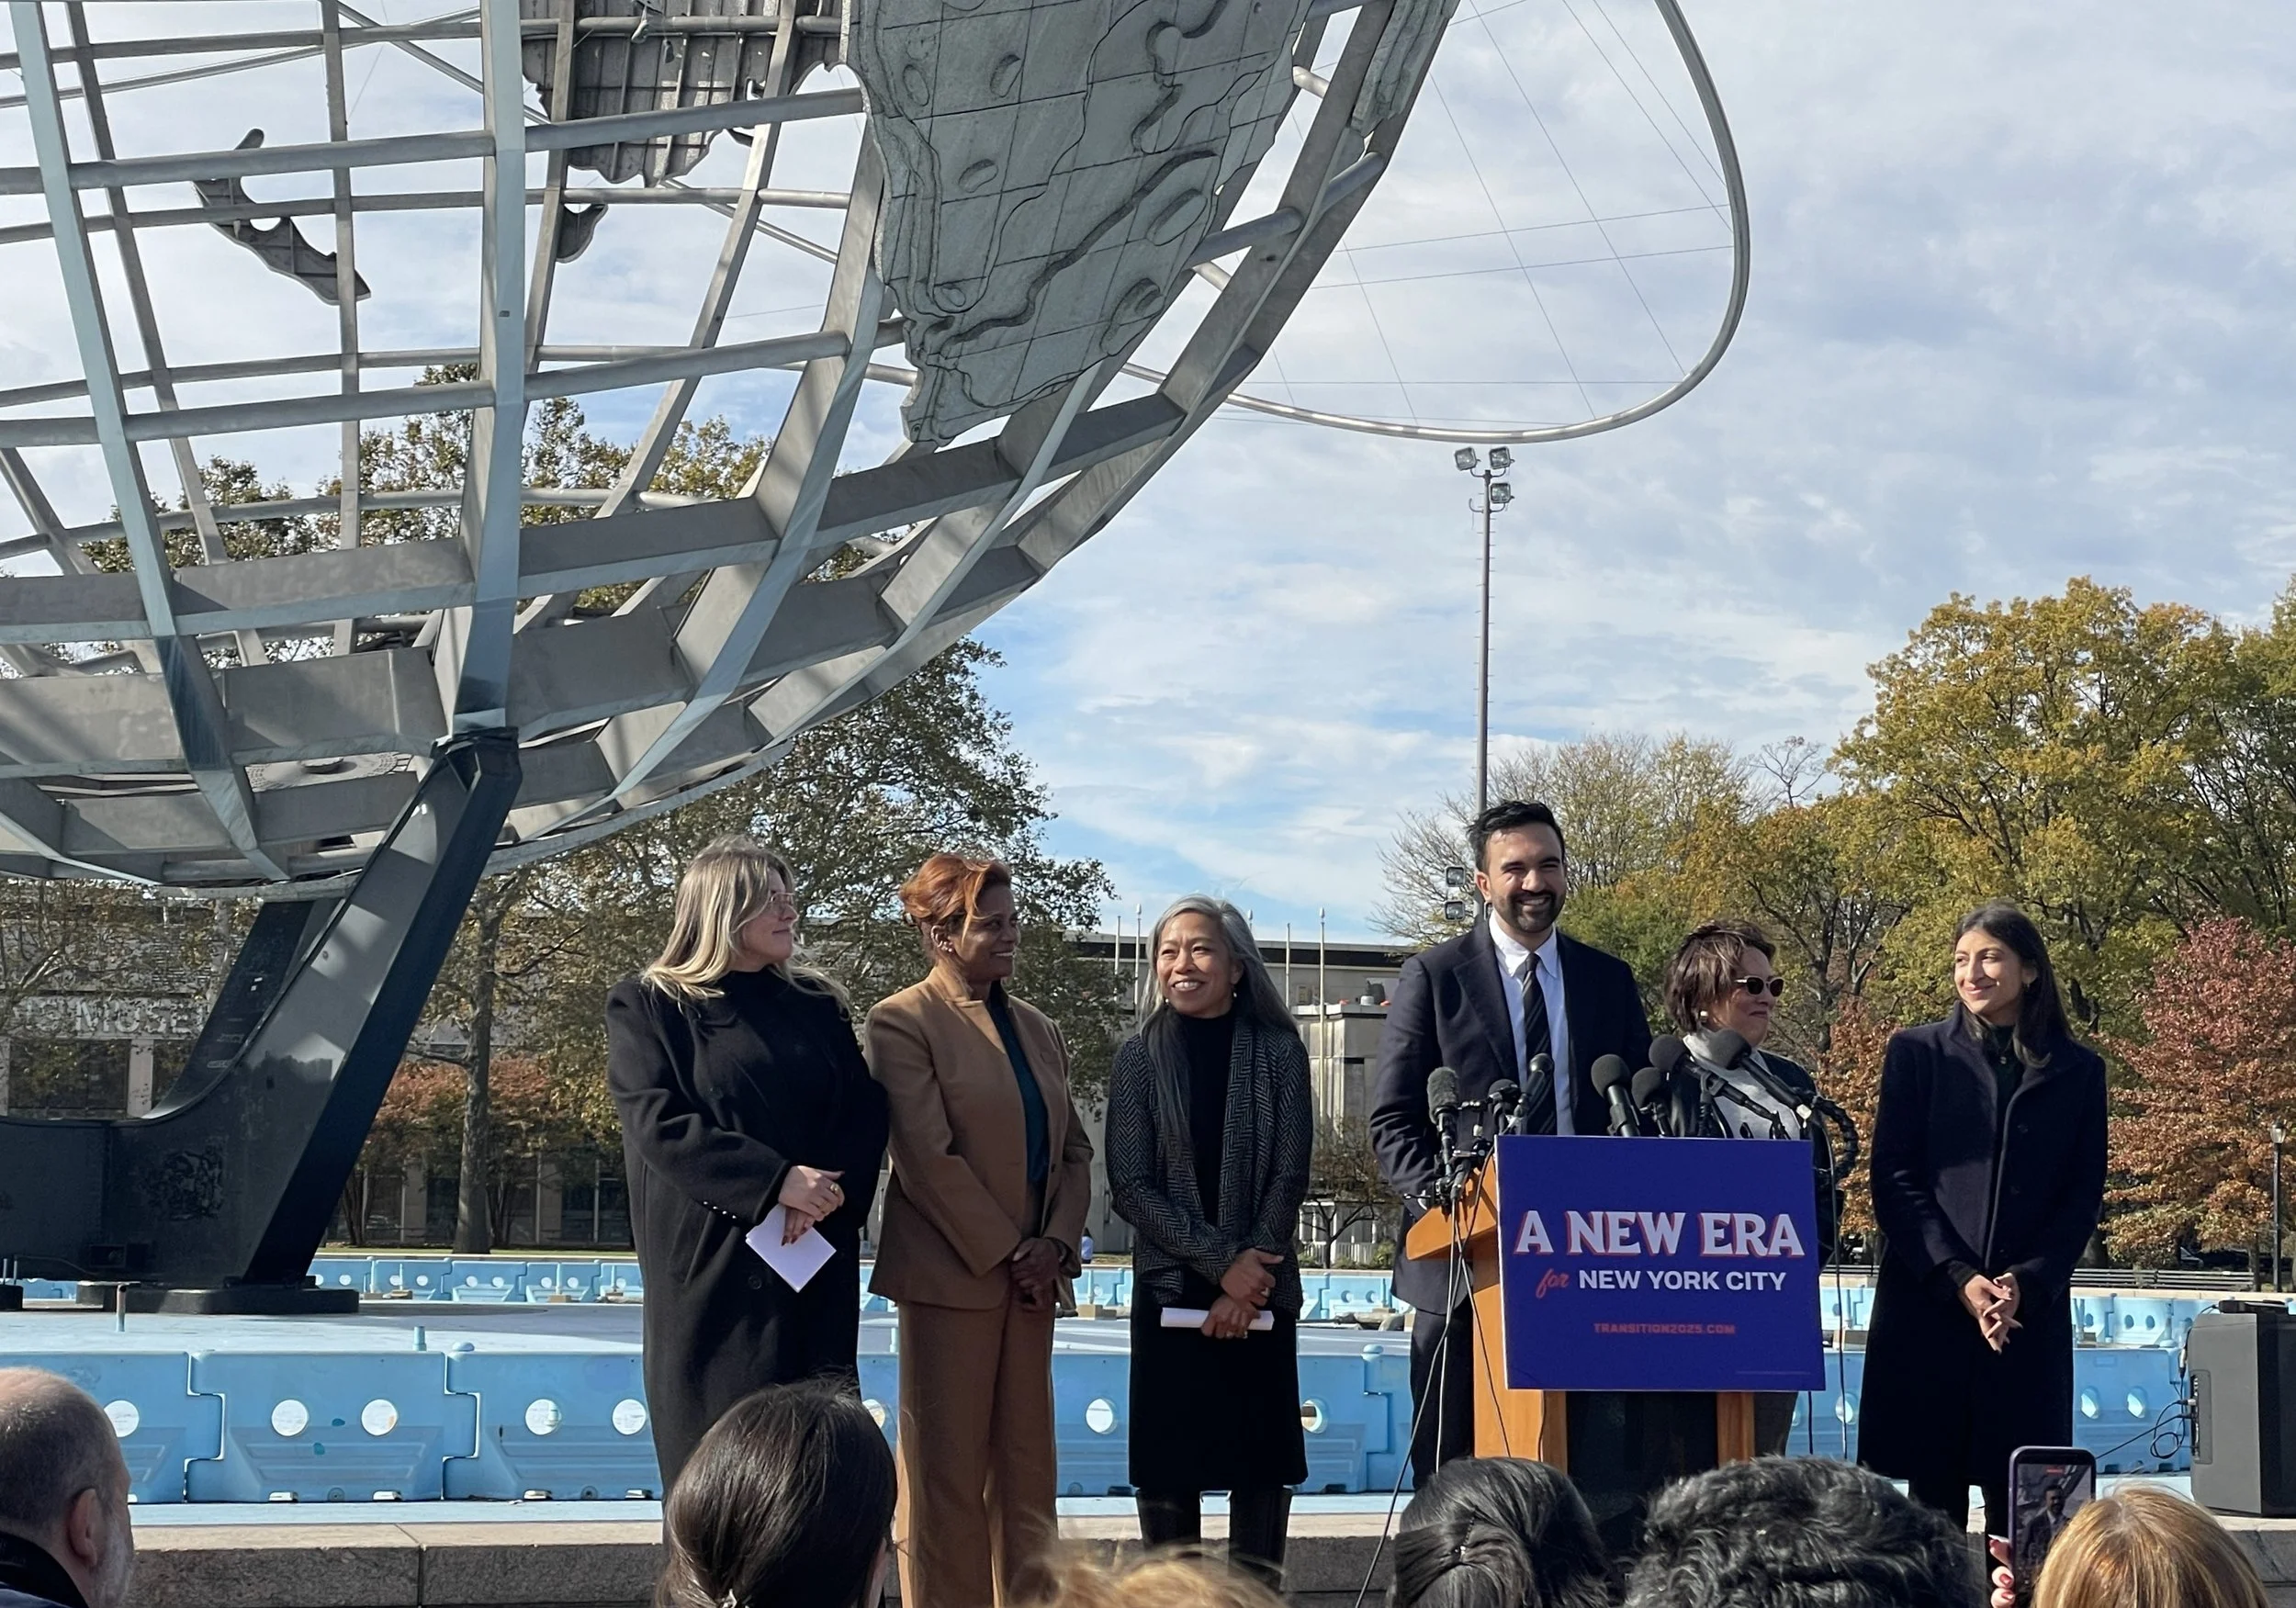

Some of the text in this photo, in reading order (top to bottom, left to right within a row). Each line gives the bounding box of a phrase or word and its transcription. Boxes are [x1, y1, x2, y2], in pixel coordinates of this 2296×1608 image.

[1514, 1209, 1806, 1258] A NEW ERA
[1536, 1268, 1787, 1299] for NEW YORK CITY
